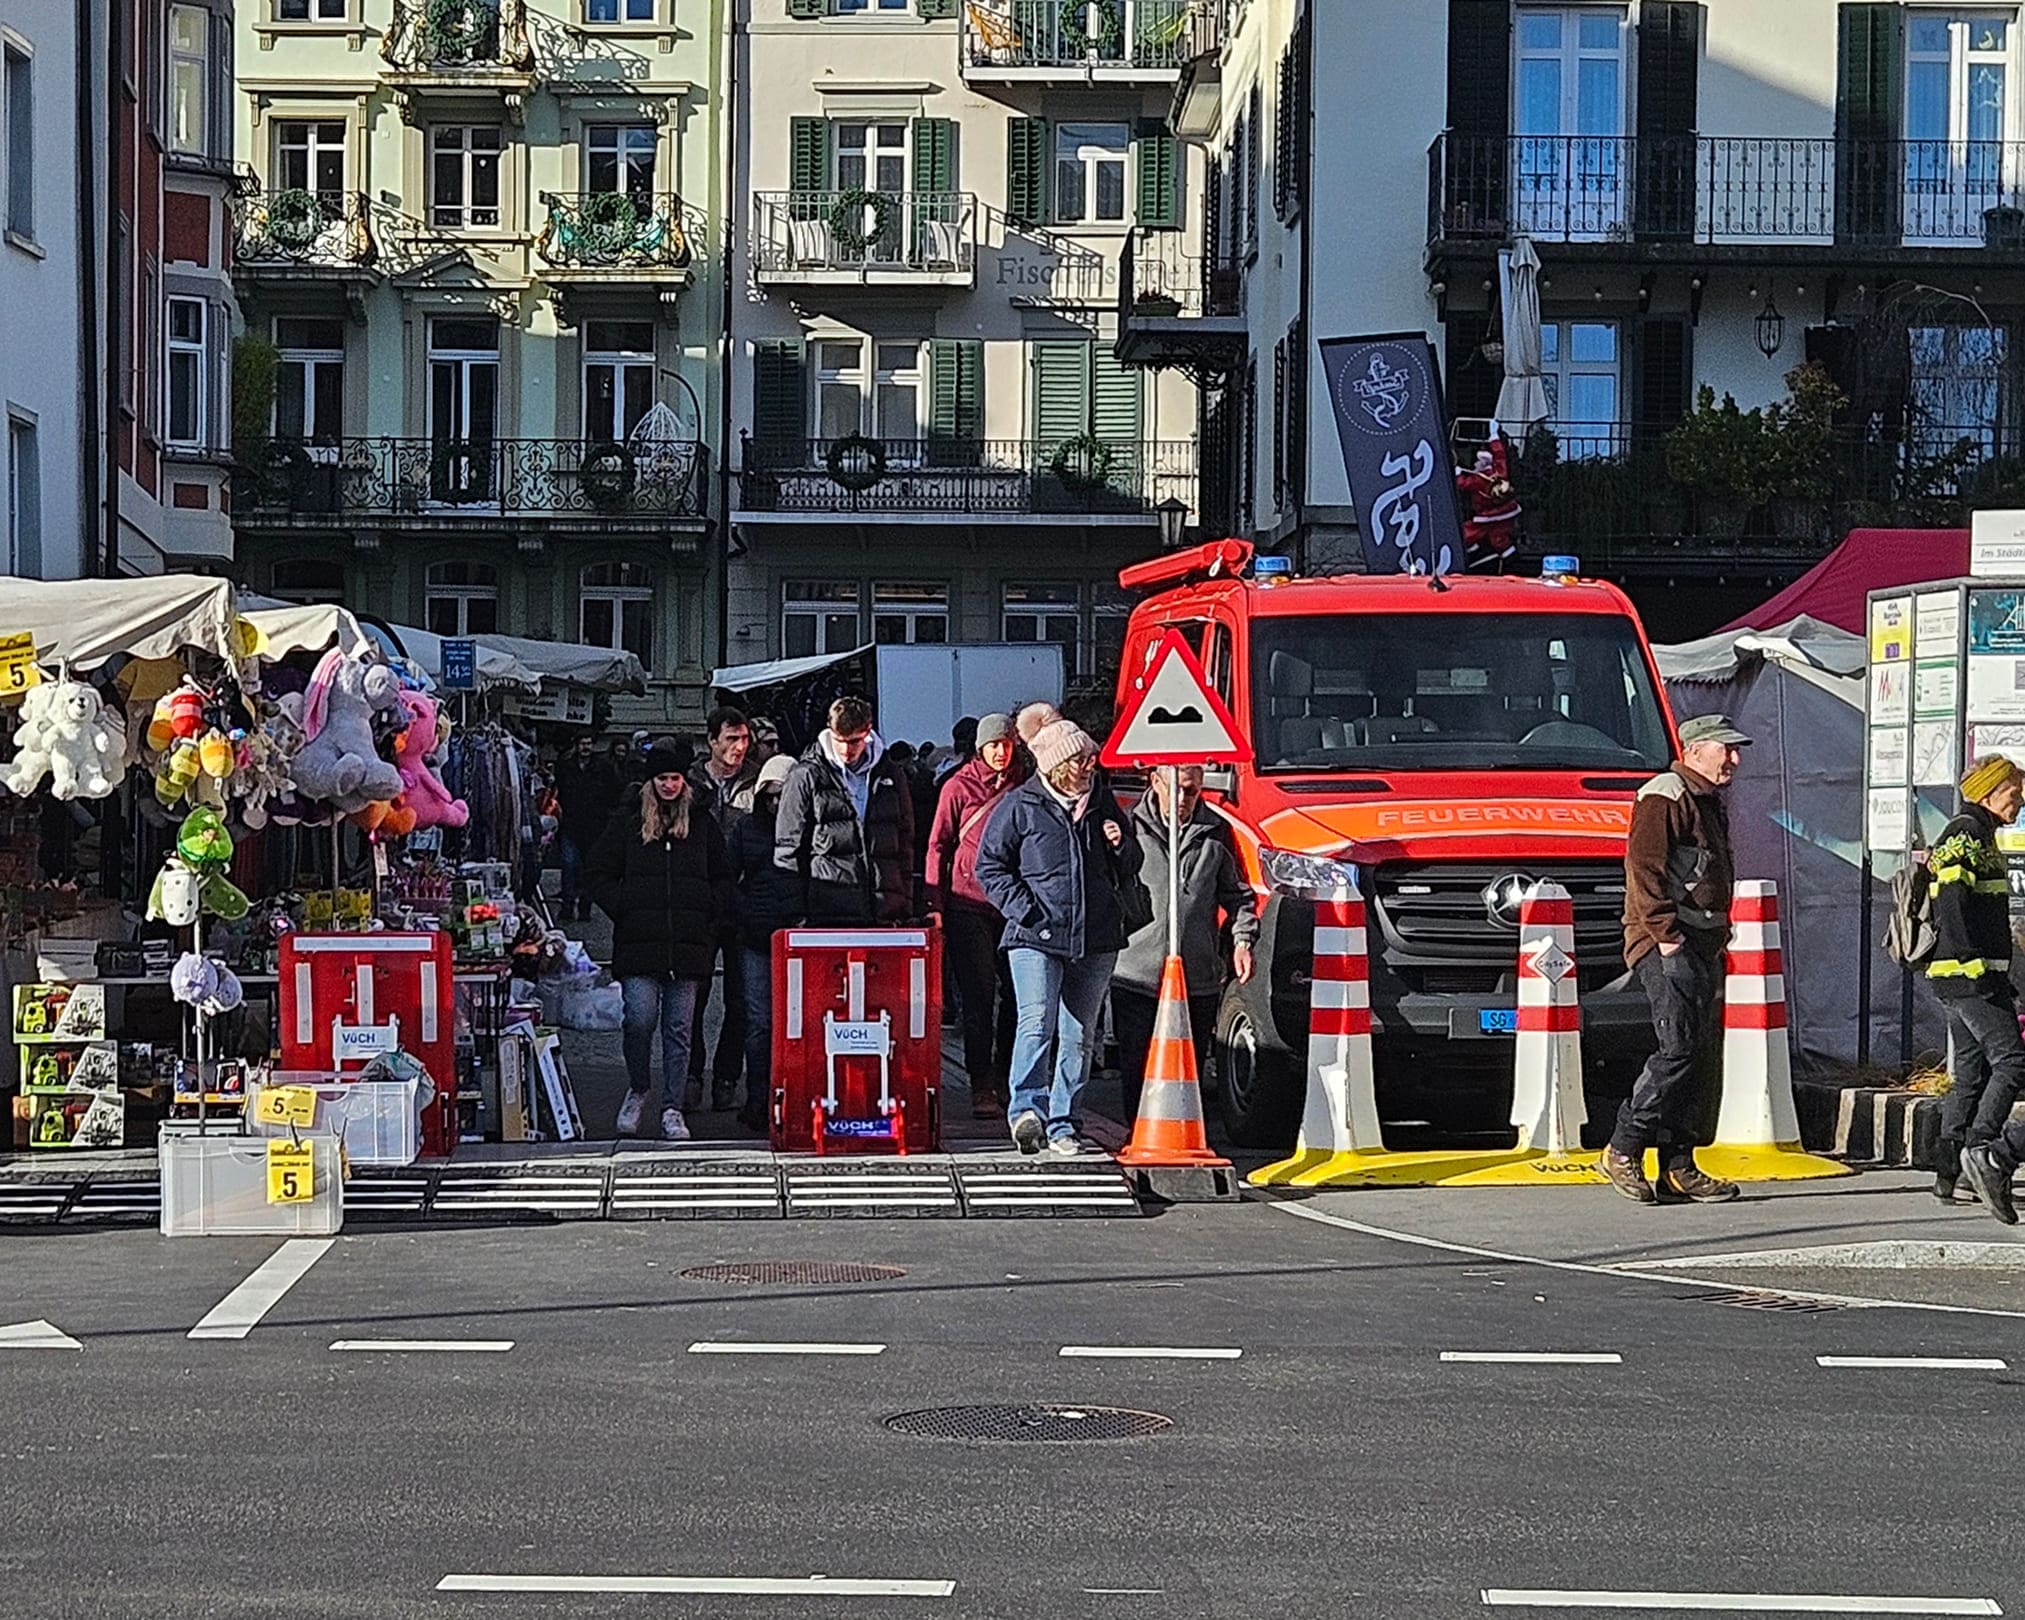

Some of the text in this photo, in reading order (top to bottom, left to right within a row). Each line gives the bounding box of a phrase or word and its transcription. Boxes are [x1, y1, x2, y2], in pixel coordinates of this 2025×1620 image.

[9, 662, 26, 687] 5
[1377, 807, 1629, 826] FEUERWEHR
[283, 1172, 298, 1198] 5
